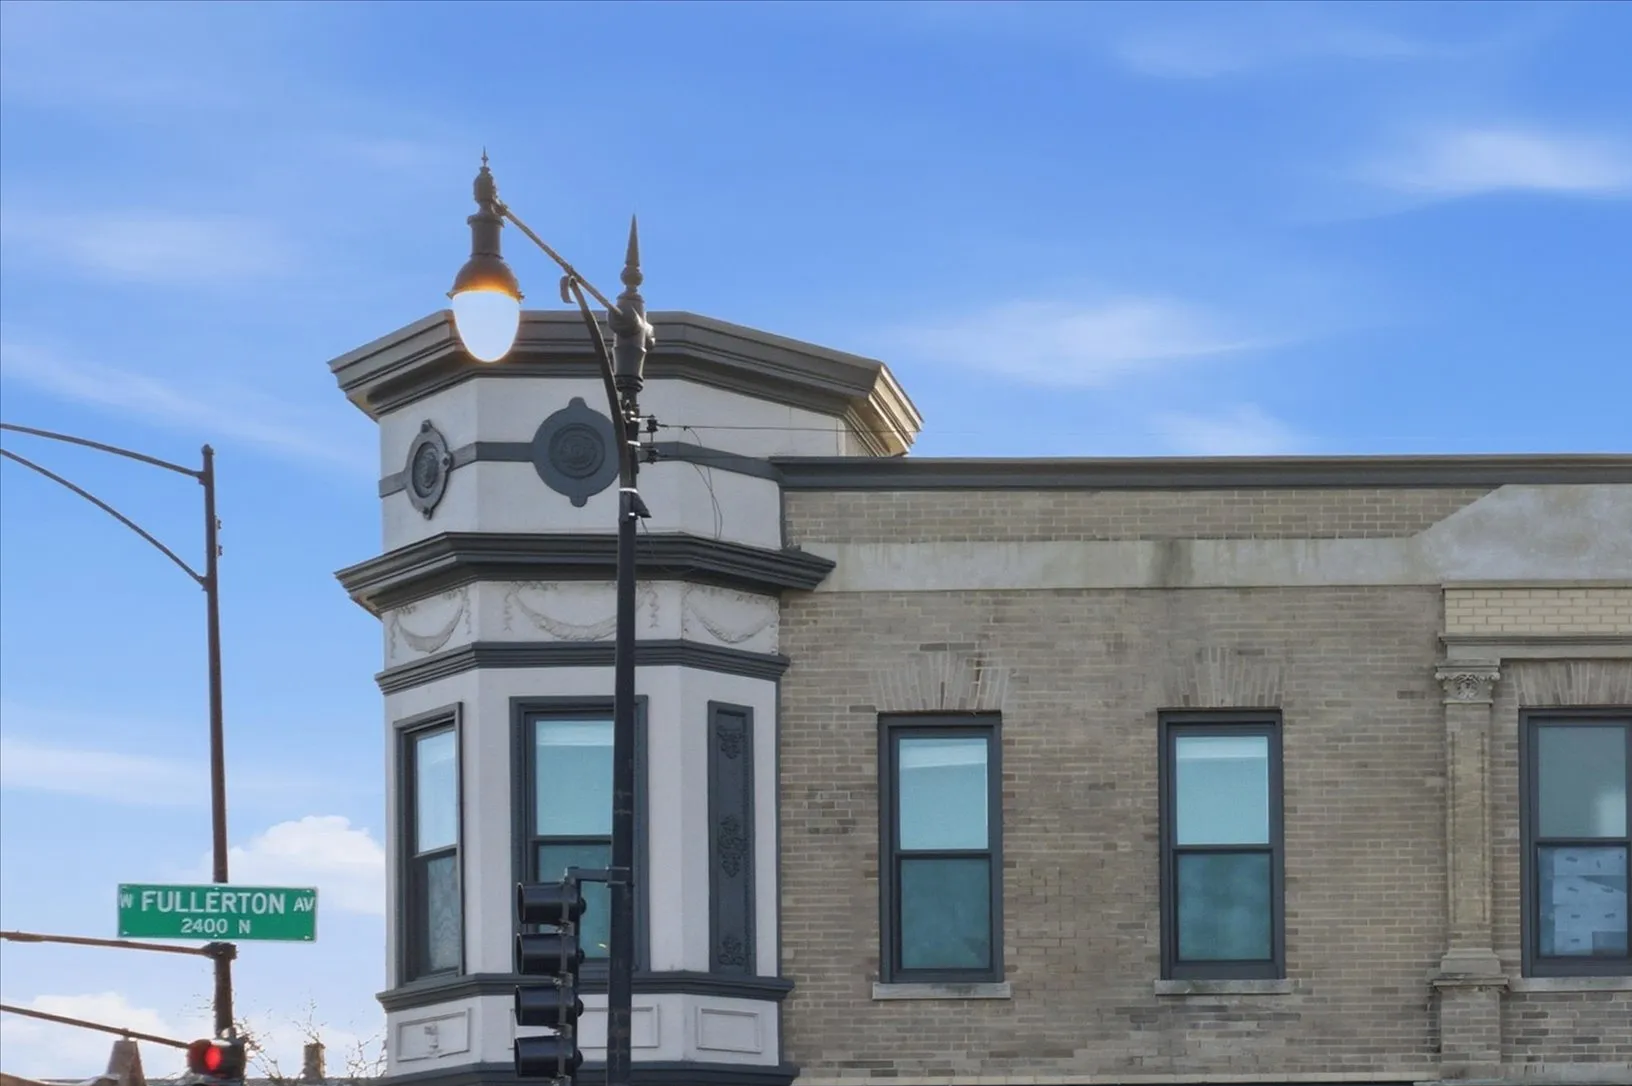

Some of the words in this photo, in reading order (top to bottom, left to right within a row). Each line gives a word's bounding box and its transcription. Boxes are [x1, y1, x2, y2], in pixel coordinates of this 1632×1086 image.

[141, 890, 286, 915] FULLERTON
[293, 896, 315, 913] AV
[180, 918, 228, 934] 2400
[238, 920, 251, 934] N
